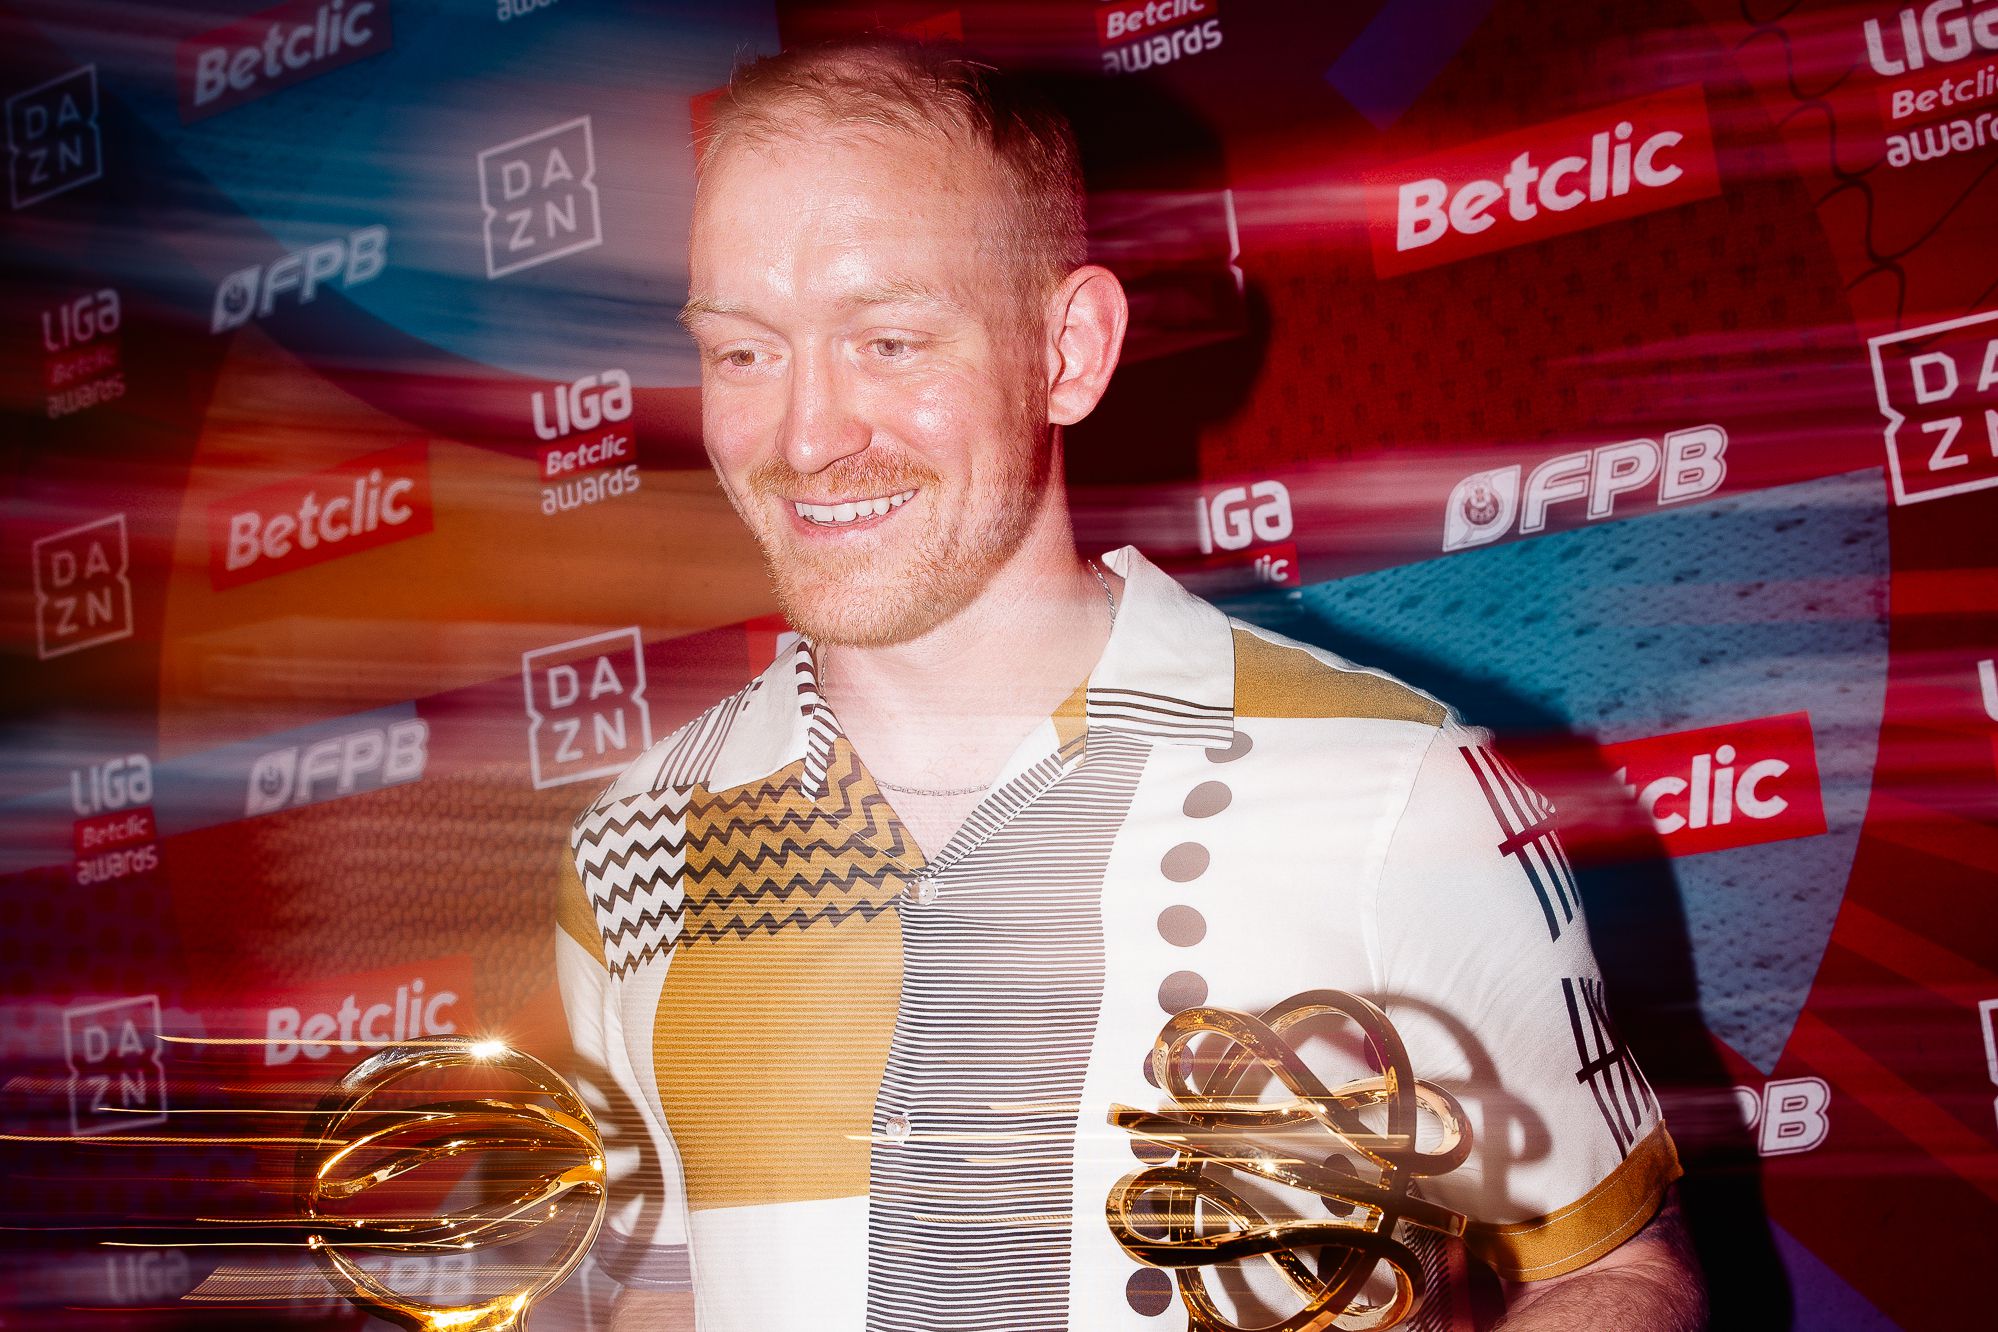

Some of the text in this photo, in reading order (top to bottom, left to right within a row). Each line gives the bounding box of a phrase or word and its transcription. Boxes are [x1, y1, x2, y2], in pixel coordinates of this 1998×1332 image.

[193, 0, 375, 107] Betclic
[1102, 19, 1222, 74] awards
[1892, 65, 1998, 119] Betcli
[1396, 121, 1684, 252] Betclic
[257, 223, 390, 318] FPB
[541, 464, 641, 515] awards
[546, 434, 627, 475] Betclic
[1518, 423, 1729, 535] FPB
[226, 468, 413, 571] Betclic
[294, 717, 430, 804] FPB
[265, 977, 458, 1066] Betclic
